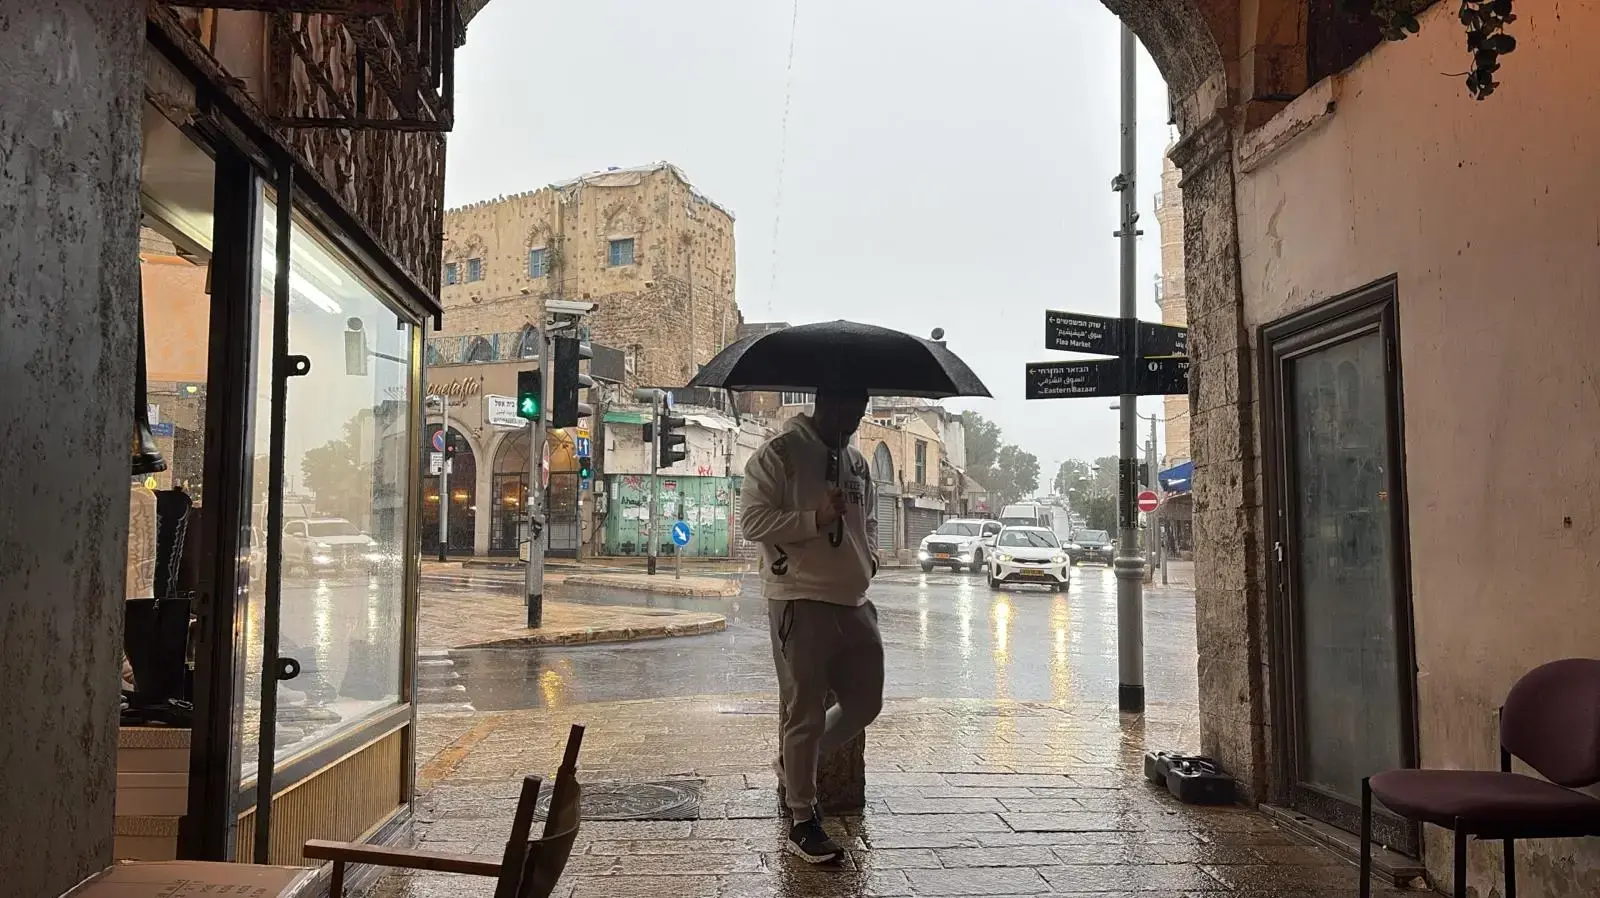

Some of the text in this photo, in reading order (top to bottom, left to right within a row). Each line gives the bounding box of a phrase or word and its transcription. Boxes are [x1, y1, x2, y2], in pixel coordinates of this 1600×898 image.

[1056, 317, 1101, 329] שוק הפשפשים
[1070, 340, 1091, 348] Market
[1038, 366, 1089, 376] הבזאר המזרחי
